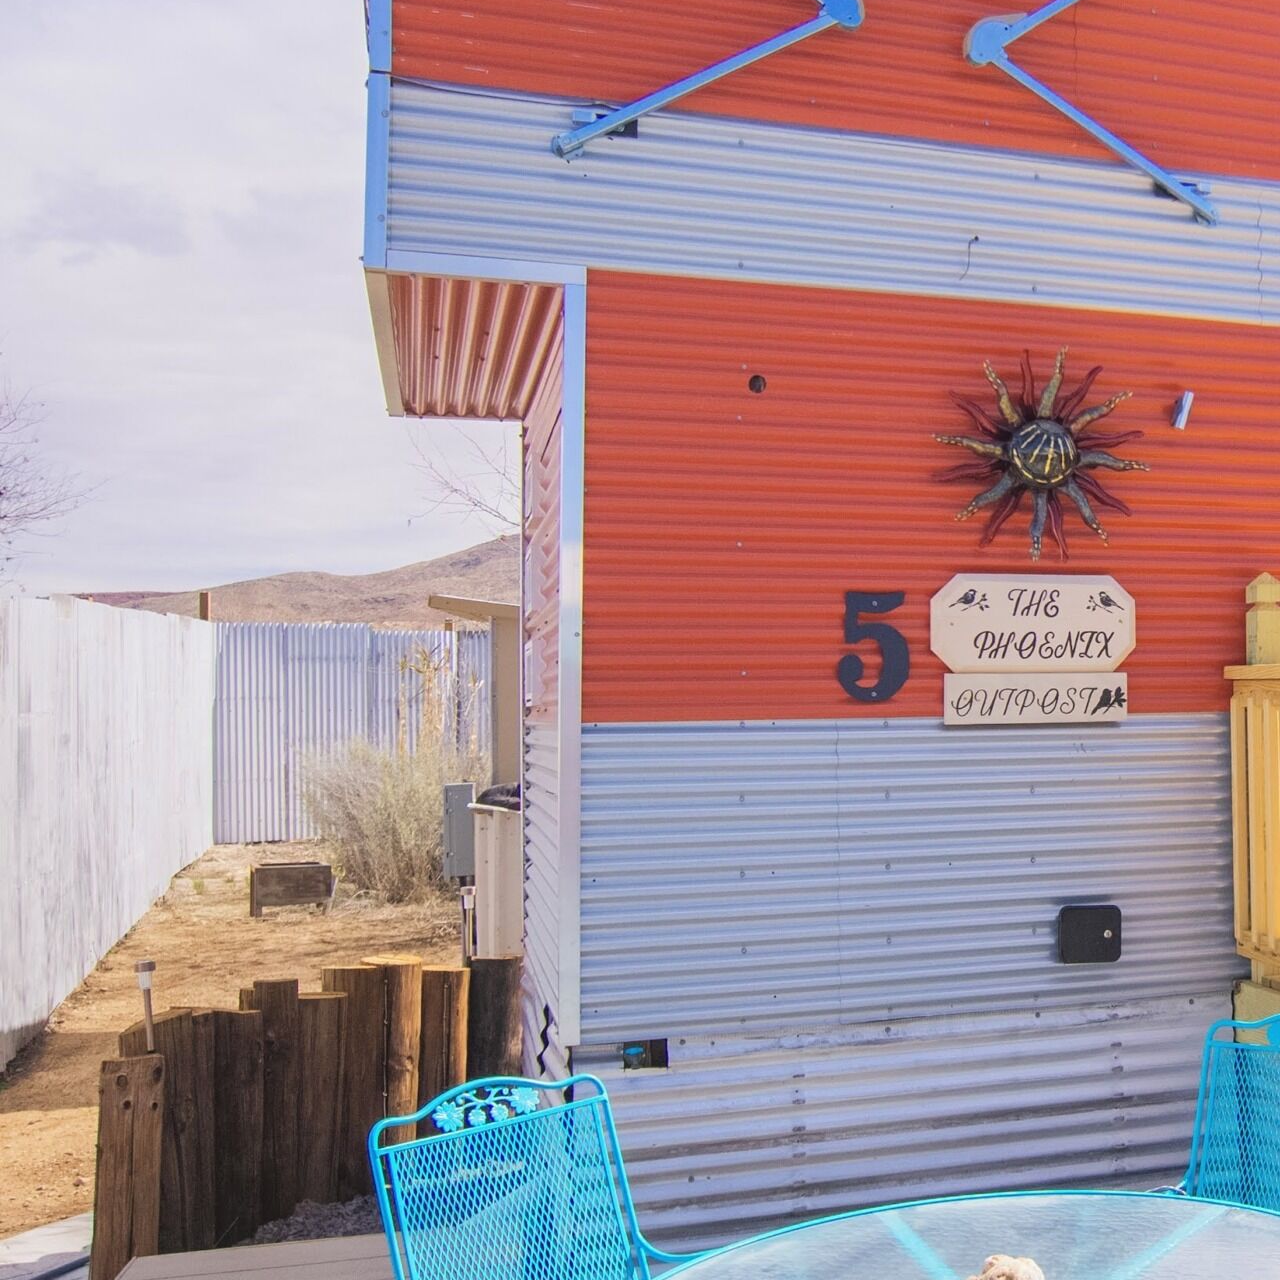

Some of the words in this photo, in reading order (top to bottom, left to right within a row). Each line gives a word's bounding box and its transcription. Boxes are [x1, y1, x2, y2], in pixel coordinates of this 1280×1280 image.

[1007, 588, 1061, 618] THE
[838, 591, 910, 702] 5
[973, 631, 1115, 660] PHOENIX
[951, 688, 1098, 716] OUTPOST
